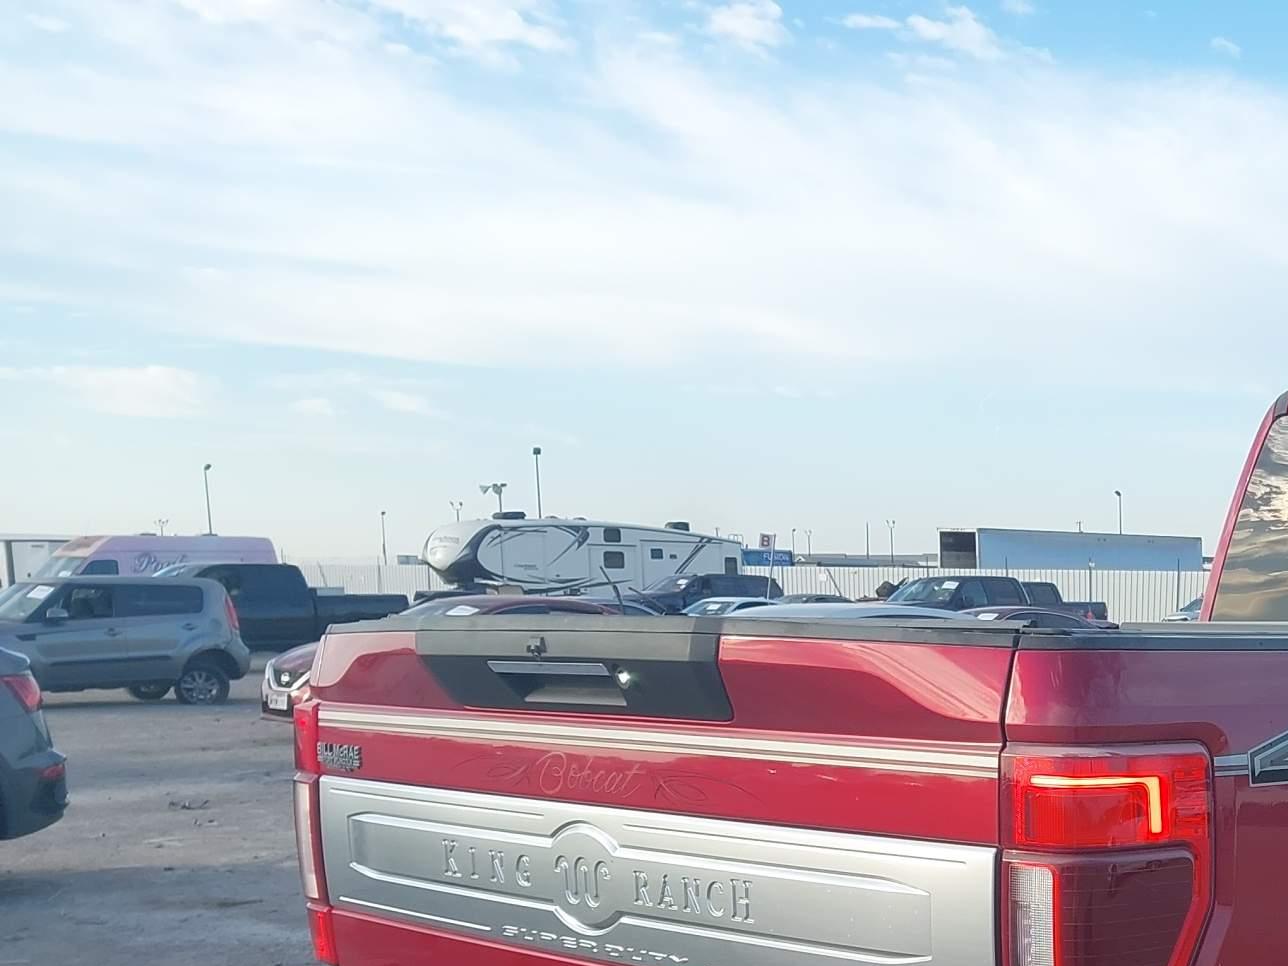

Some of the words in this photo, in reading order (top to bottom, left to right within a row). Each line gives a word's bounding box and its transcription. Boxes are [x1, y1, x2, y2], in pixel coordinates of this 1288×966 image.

[761, 535, 770, 547] B
[535, 751, 647, 799] Bobcat
[437, 838, 532, 887] KING
[631, 869, 756, 924] RANCH
